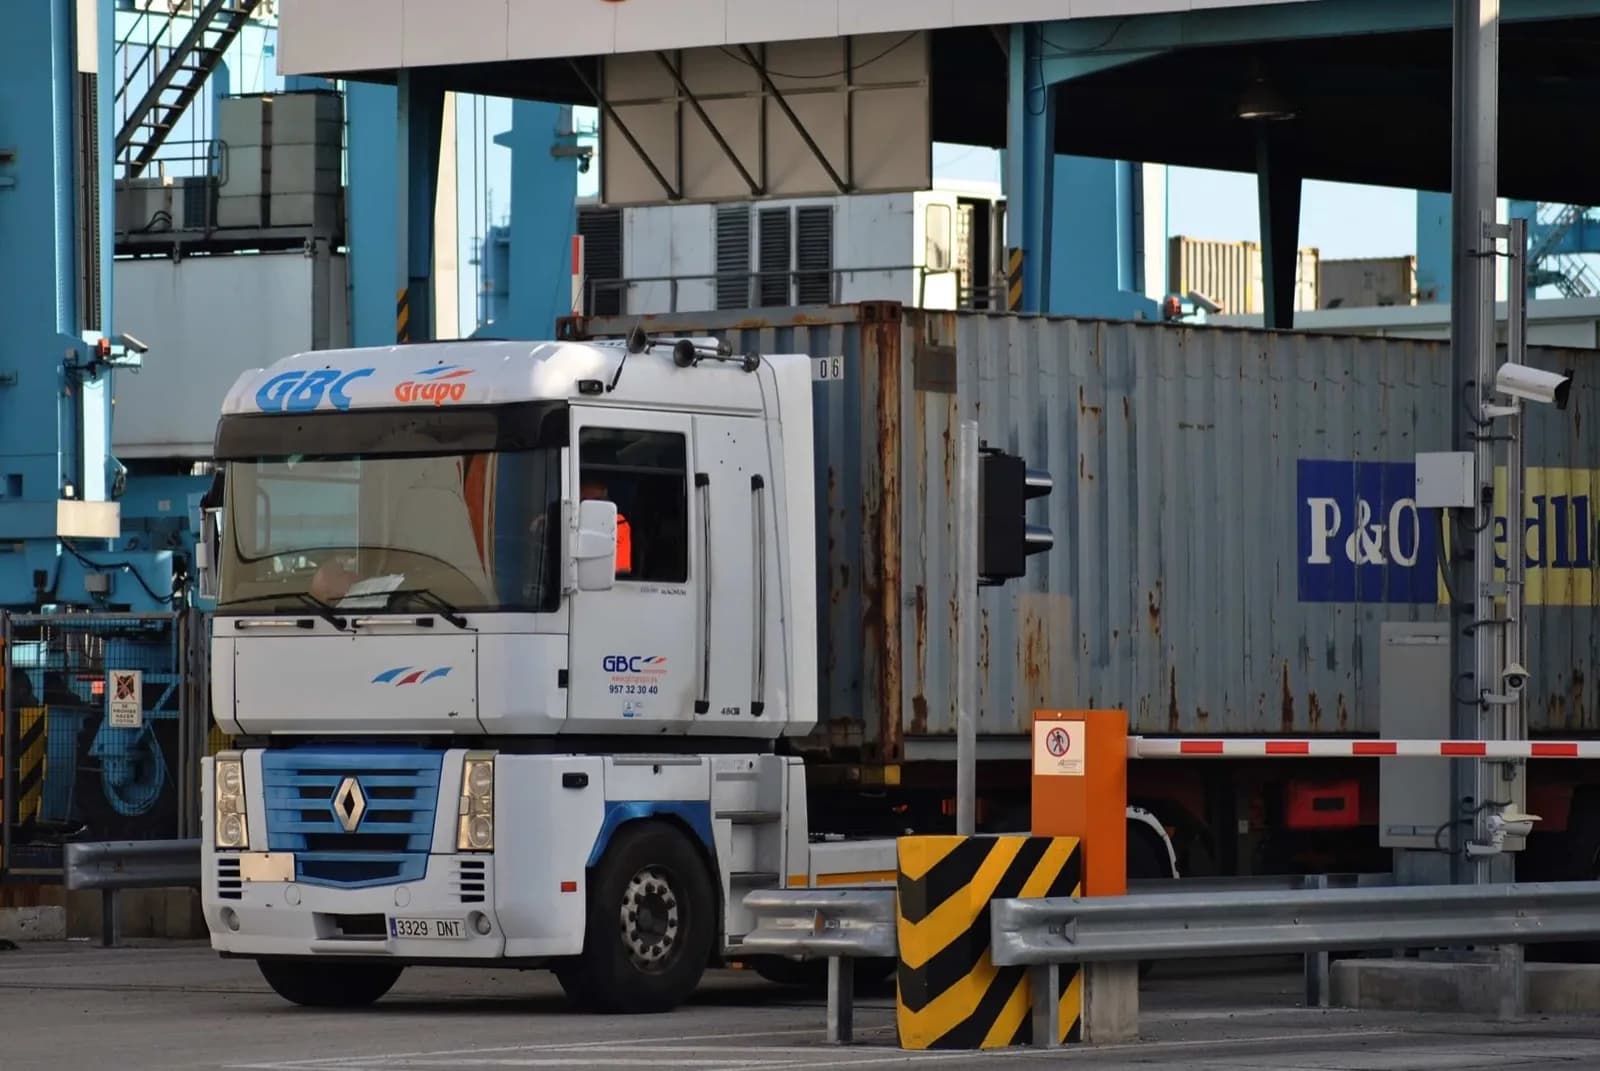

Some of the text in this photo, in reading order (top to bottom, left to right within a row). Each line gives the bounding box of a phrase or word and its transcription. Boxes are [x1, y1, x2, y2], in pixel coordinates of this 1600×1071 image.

[256, 368, 376, 412] GBC
[395, 381, 466, 406] Grupo
[1307, 497, 1419, 567] P&O
[603, 655, 641, 673] GBC
[609, 685, 658, 695] 957 32 30 40
[397, 920, 460, 937] 3329 DNT
